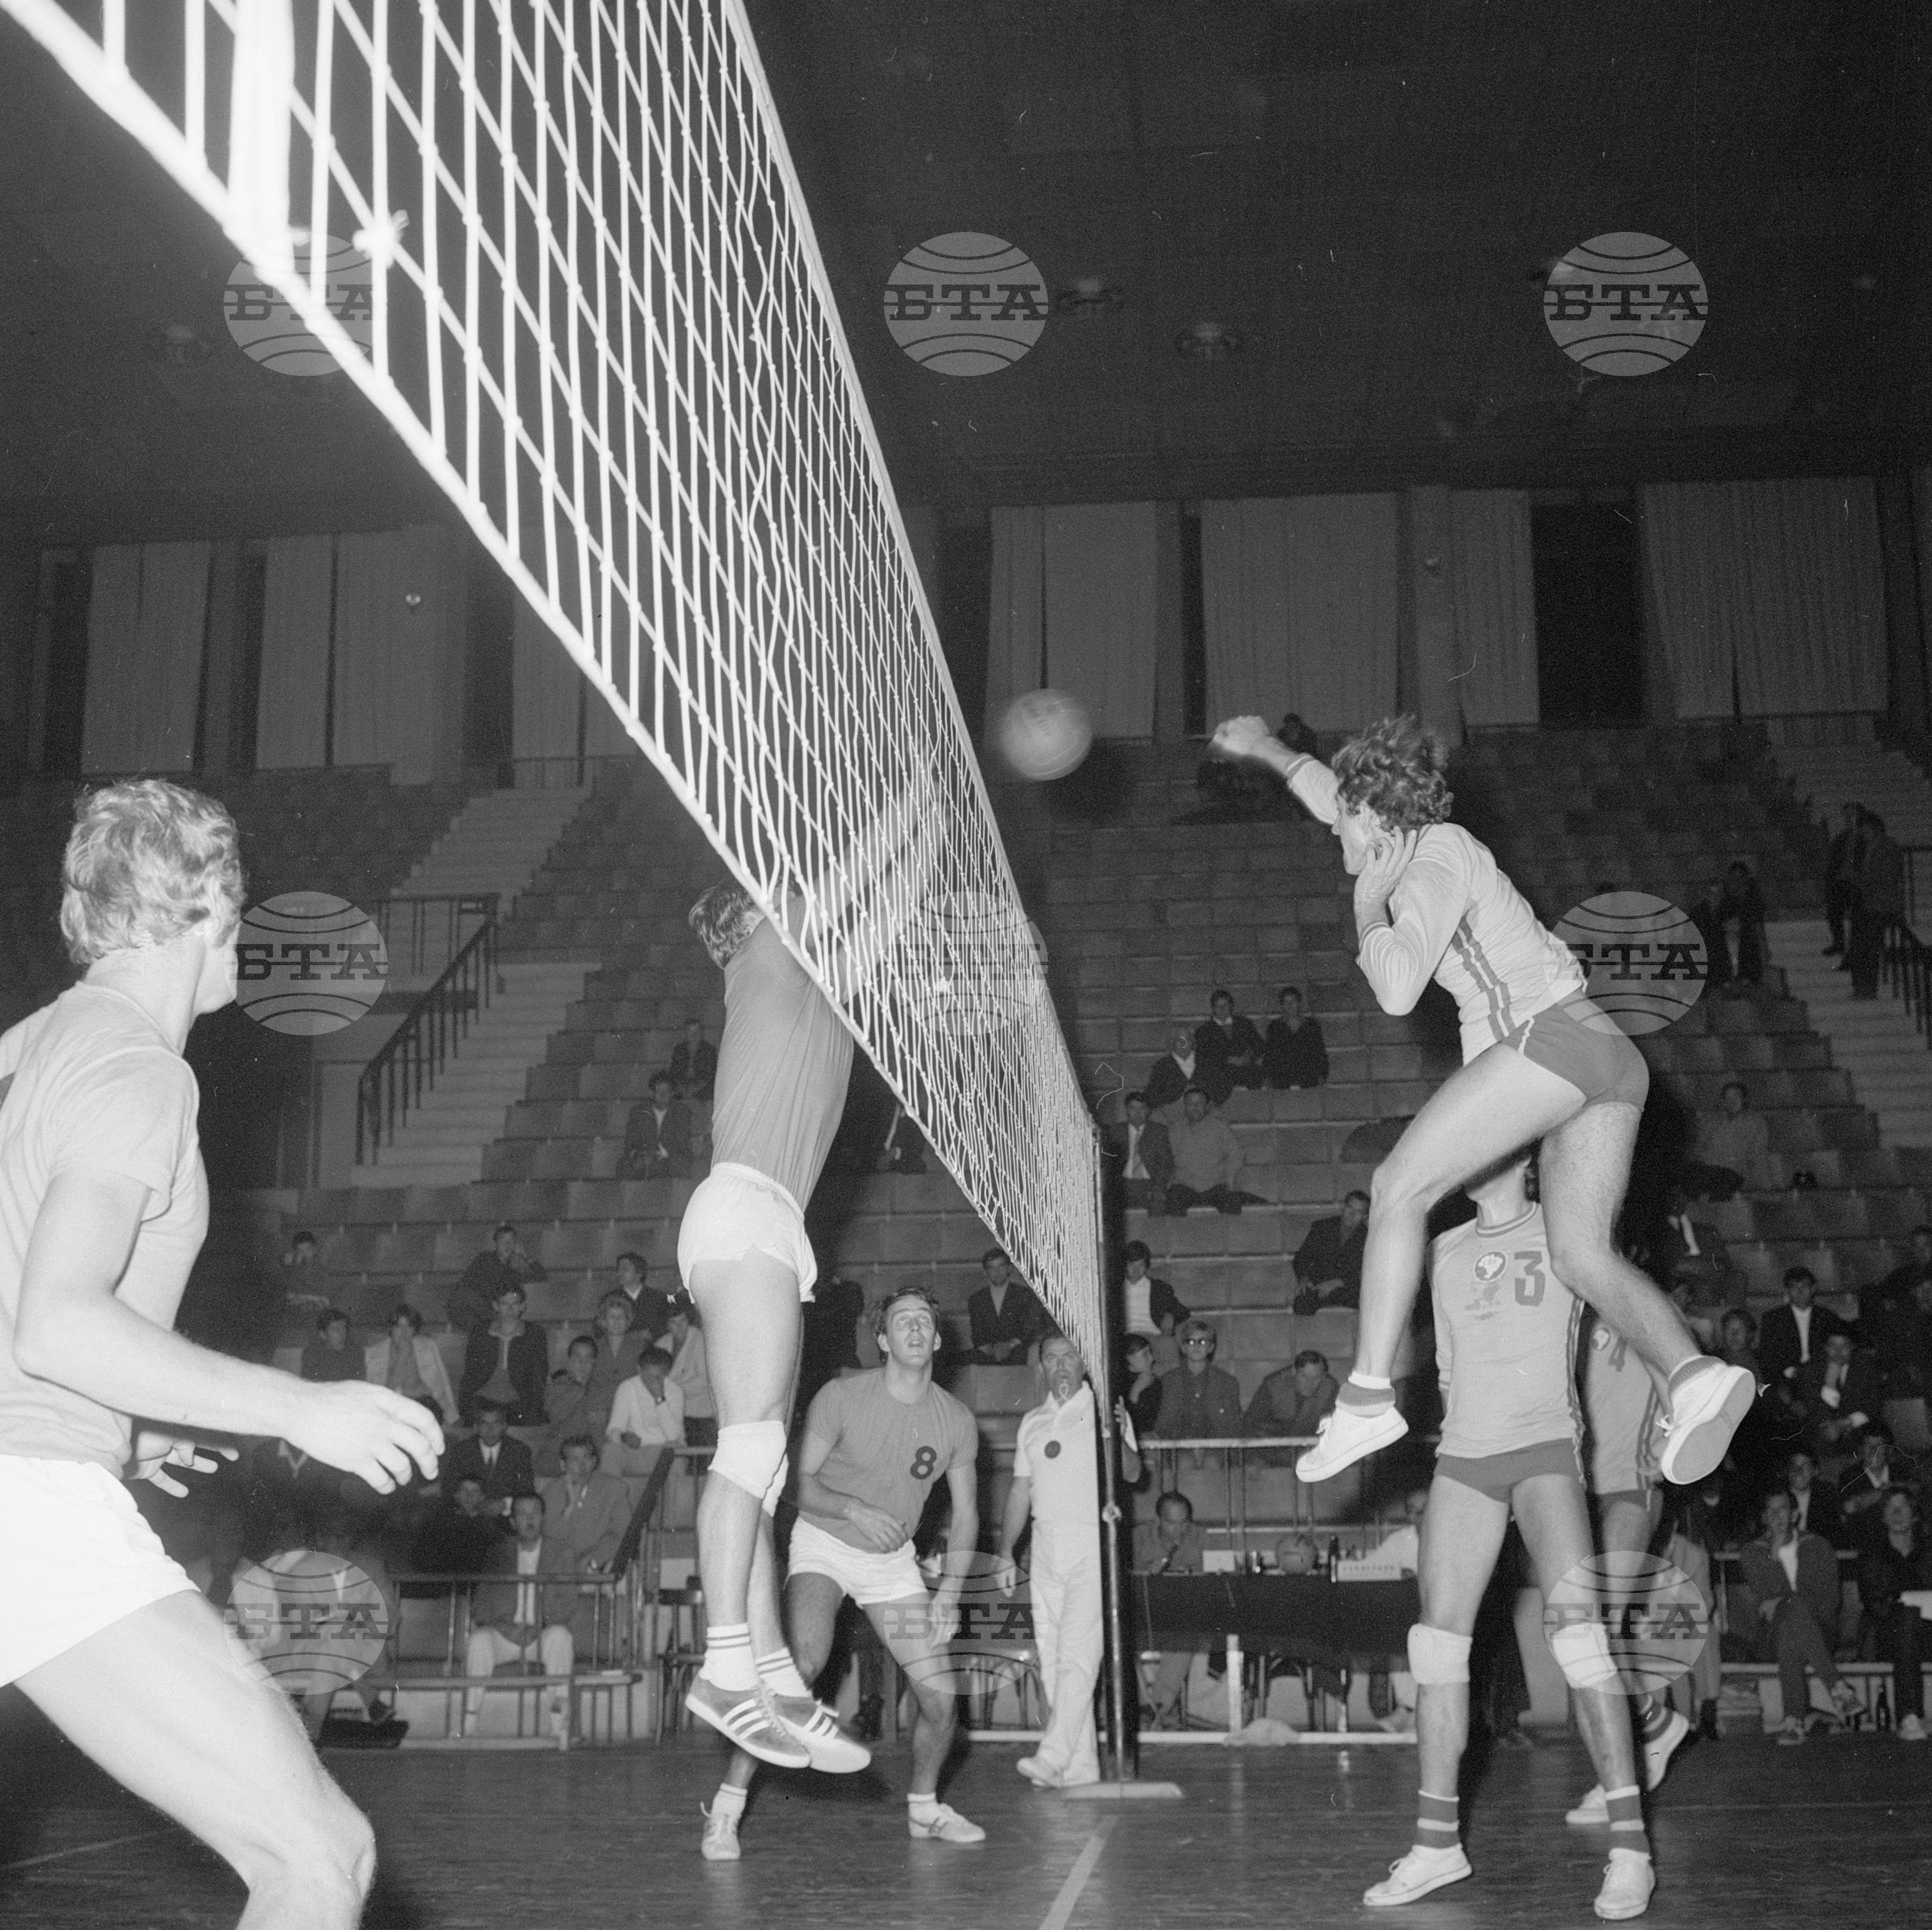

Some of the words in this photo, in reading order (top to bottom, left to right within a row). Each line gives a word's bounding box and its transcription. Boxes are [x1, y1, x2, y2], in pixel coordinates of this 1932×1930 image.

[1514, 1250, 1545, 1306] 3
[1608, 1335, 1627, 1372] 4
[910, 1445, 937, 1479] 8
